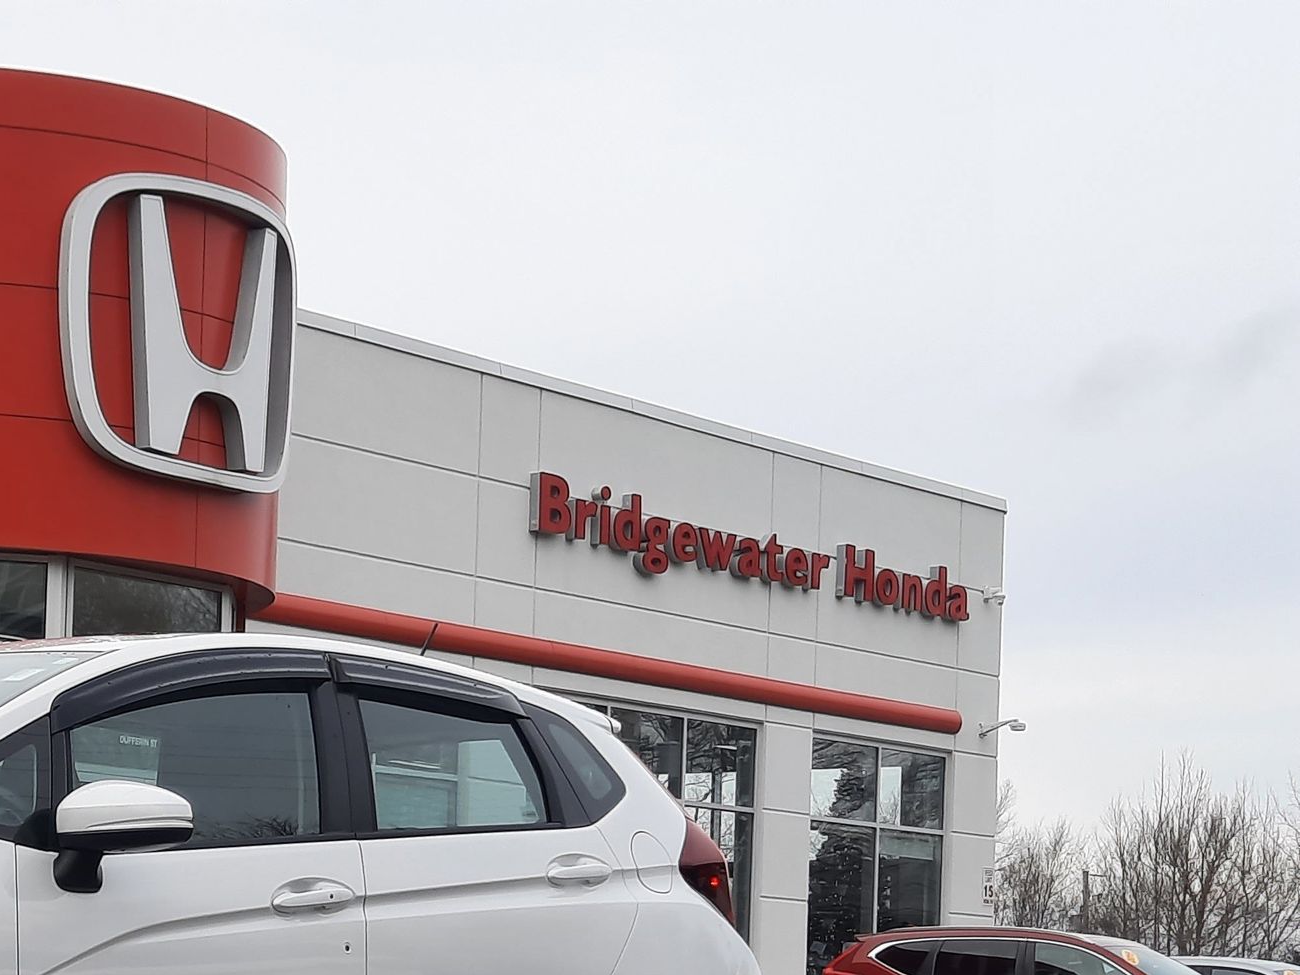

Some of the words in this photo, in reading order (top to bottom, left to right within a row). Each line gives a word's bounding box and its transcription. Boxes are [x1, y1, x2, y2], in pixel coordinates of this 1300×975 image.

[534, 471, 830, 590] Bridgewater
[840, 543, 969, 622] Honda
[983, 884, 994, 898] 15
